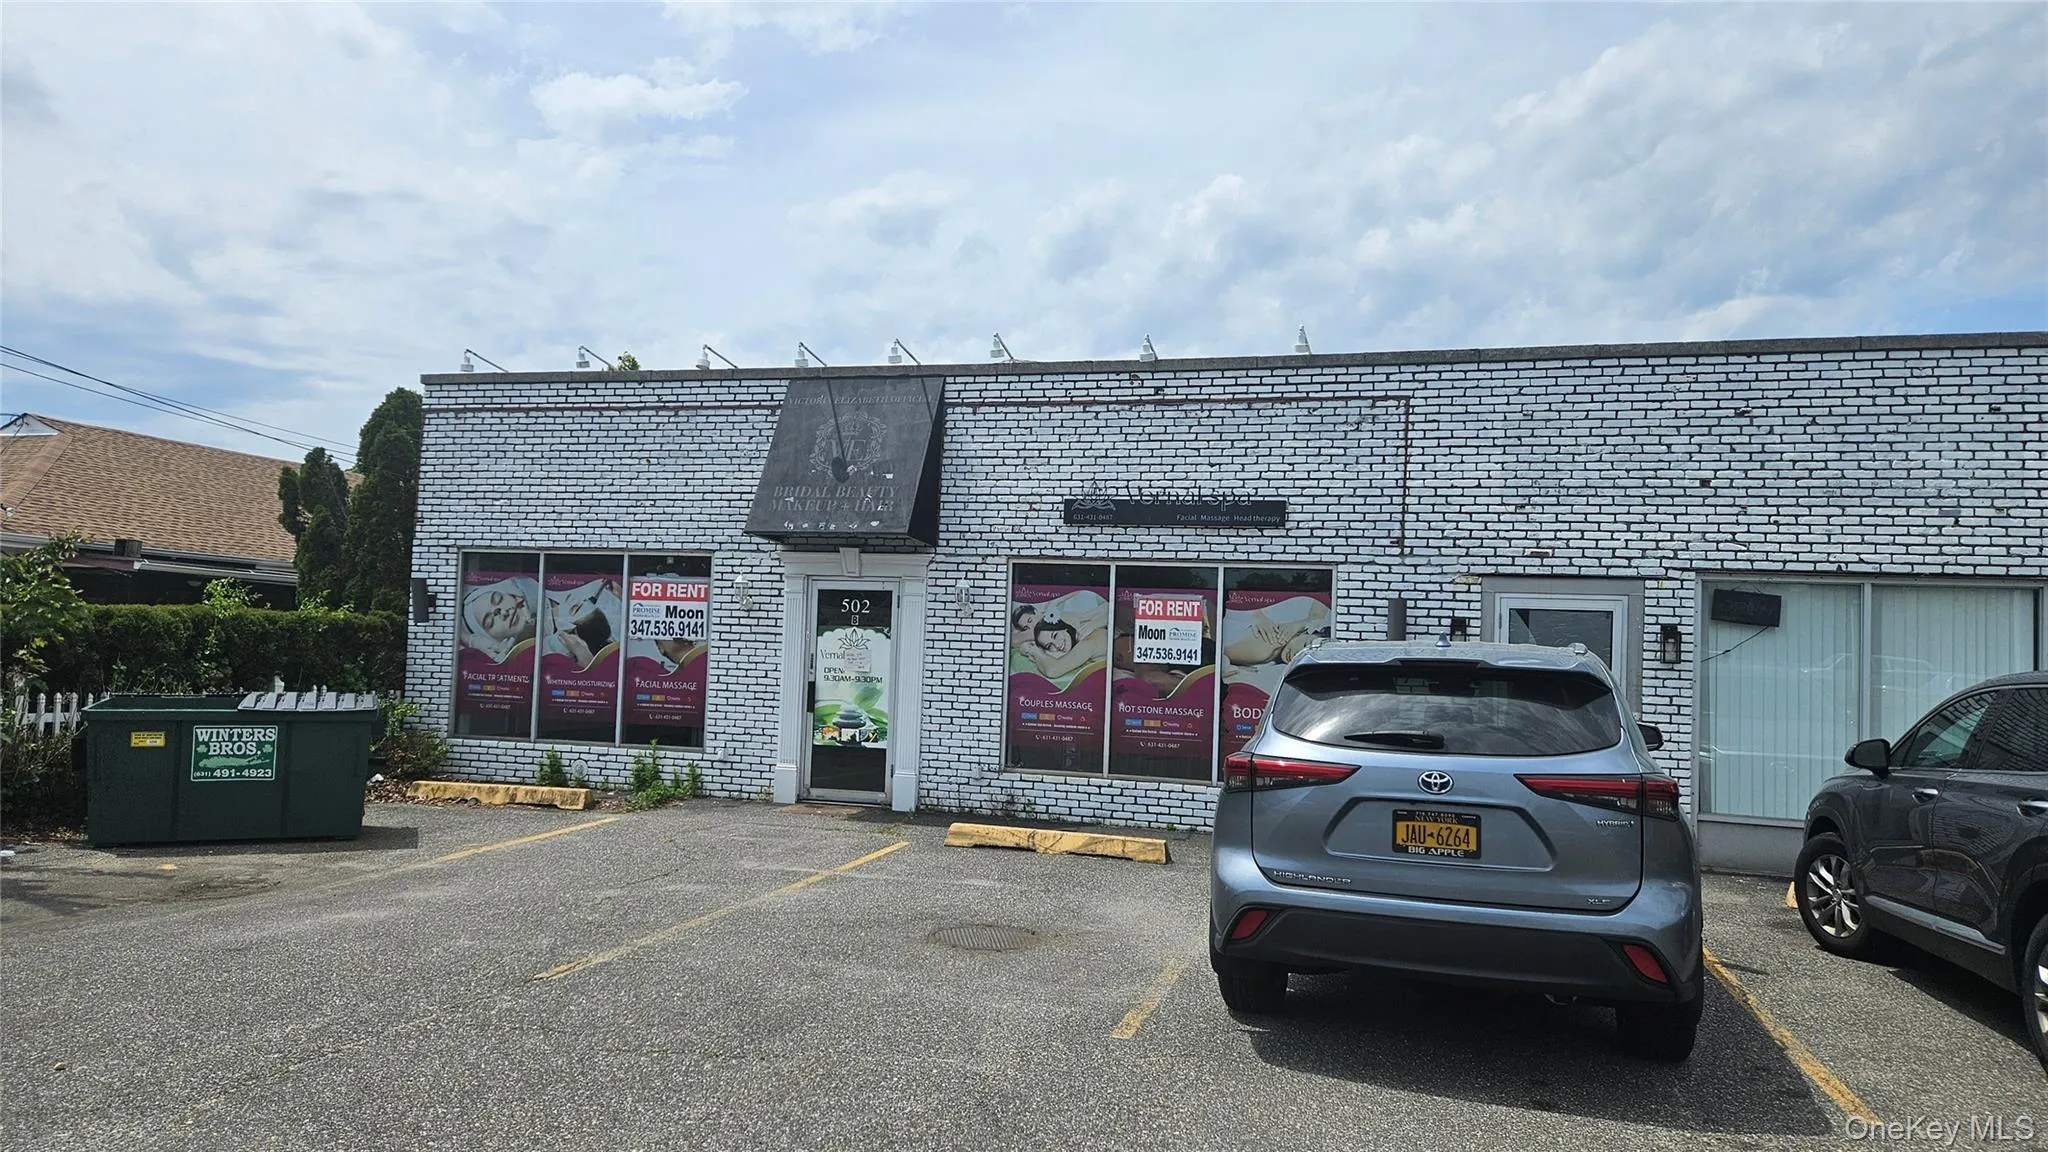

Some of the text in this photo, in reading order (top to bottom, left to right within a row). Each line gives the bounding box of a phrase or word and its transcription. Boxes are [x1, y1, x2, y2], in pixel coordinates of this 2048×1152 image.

[774, 486, 831, 497] BRIDAL
[1207, 490, 1252, 511] spa
[1200, 515, 1230, 523] Massage
[632, 582, 708, 598] FOR RENT
[665, 605, 704, 619] Moon
[841, 599, 870, 613] 502
[1138, 600, 1200, 617] FOR RENT
[630, 619, 705, 638] 347.536.9141
[1138, 625, 1166, 641] Moon
[1136, 646, 1198, 661] 347.536.9141
[463, 672, 487, 681] FACIAL
[635, 679, 697, 691] FACIAL MASSAGE
[1019, 698, 1093, 711] COUPLES MASSAGE
[1119, 704, 1204, 717] HOT STONE MASSAGE
[195, 728, 276, 741] WINTERS
[208, 742, 261, 755] BROS.
[212, 768, 272, 777] 491-4923
[1401, 824, 1470, 848] JAU 6264
[1408, 846, 1465, 857] BIG APPLE
[1273, 870, 1352, 884] HIGHLANDER
